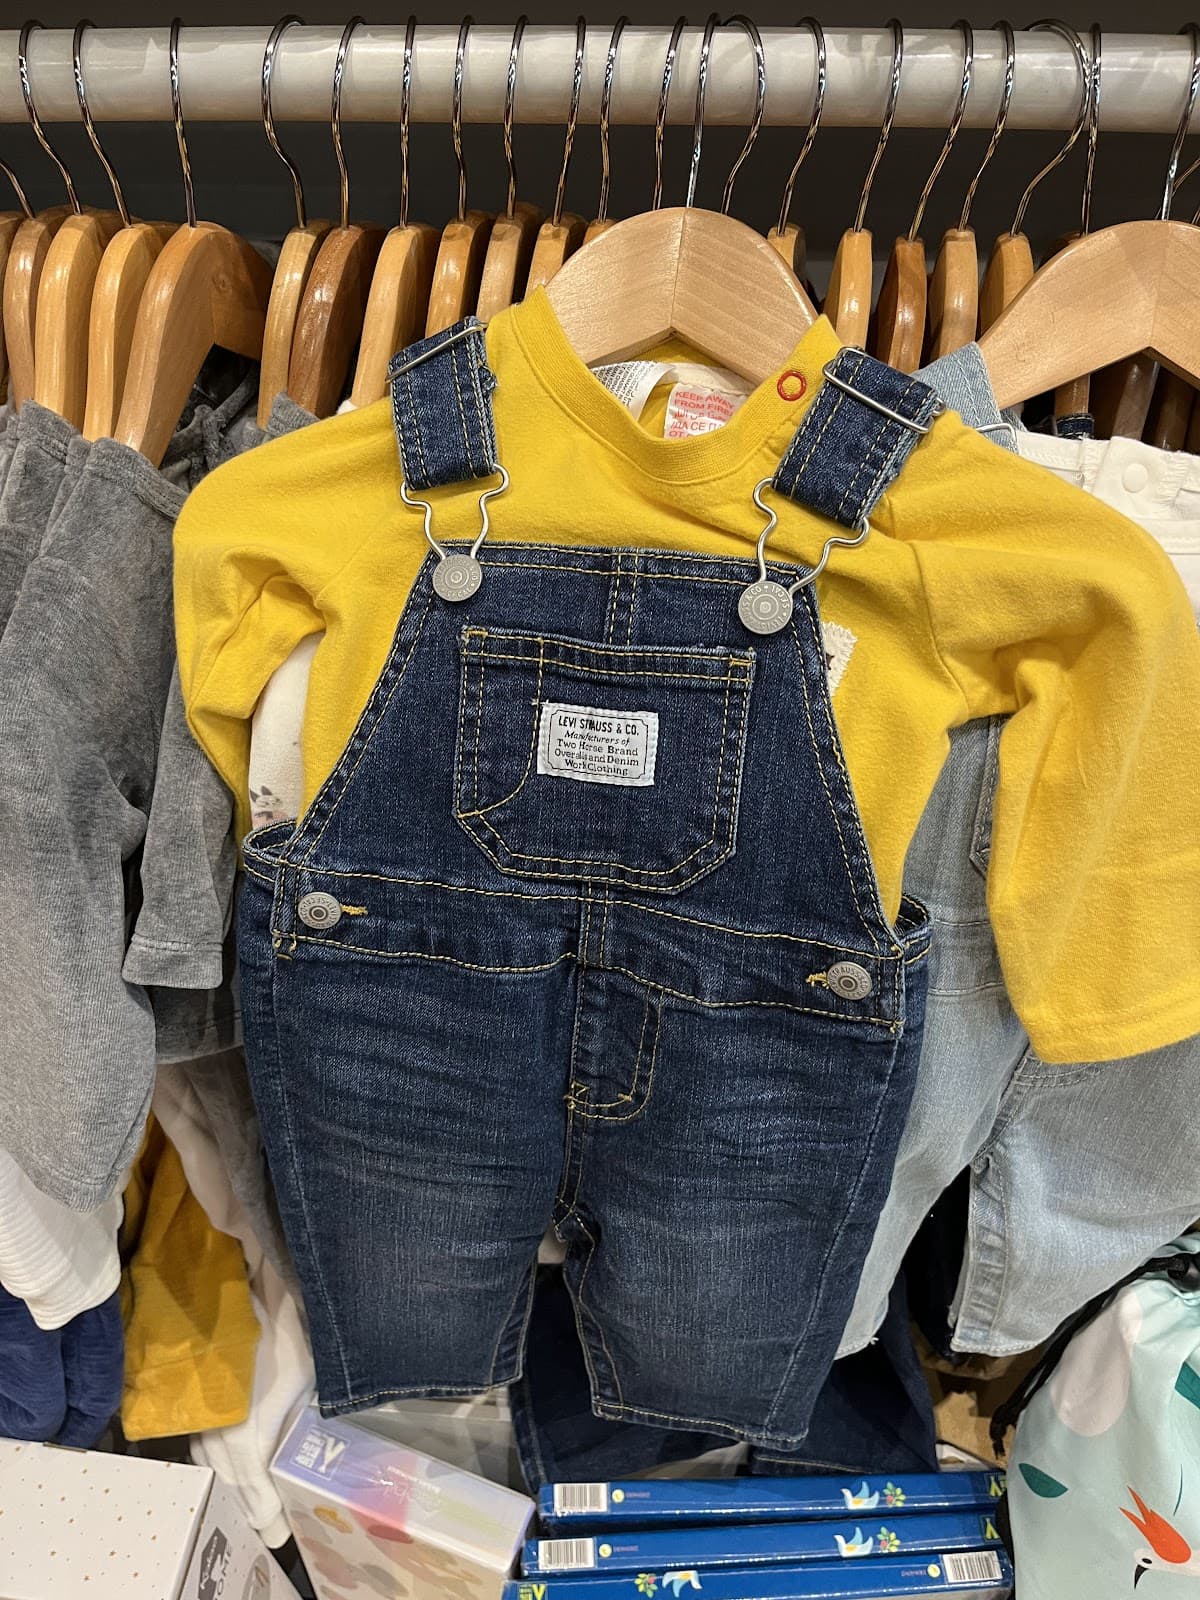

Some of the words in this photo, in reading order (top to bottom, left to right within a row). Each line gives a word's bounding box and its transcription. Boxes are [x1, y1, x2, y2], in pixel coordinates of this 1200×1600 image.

[674, 399, 705, 409] FROM
[675, 391, 704, 401] KEEP
[705, 394, 734, 409] AWAY
[558, 715, 577, 729] LEVI
[579, 718, 613, 733] STRAUSS
[616, 723, 622, 734] &
[625, 724, 640, 736] CO.
[557, 738, 577, 749] Two
[579, 741, 604, 753] Horse
[607, 745, 638, 756] Brand
[621, 737, 630, 747] of
[565, 759, 587, 770] Work
[587, 762, 628, 776] Clothing
[588, 754, 606, 763] and
[607, 755, 639, 766] Denim
